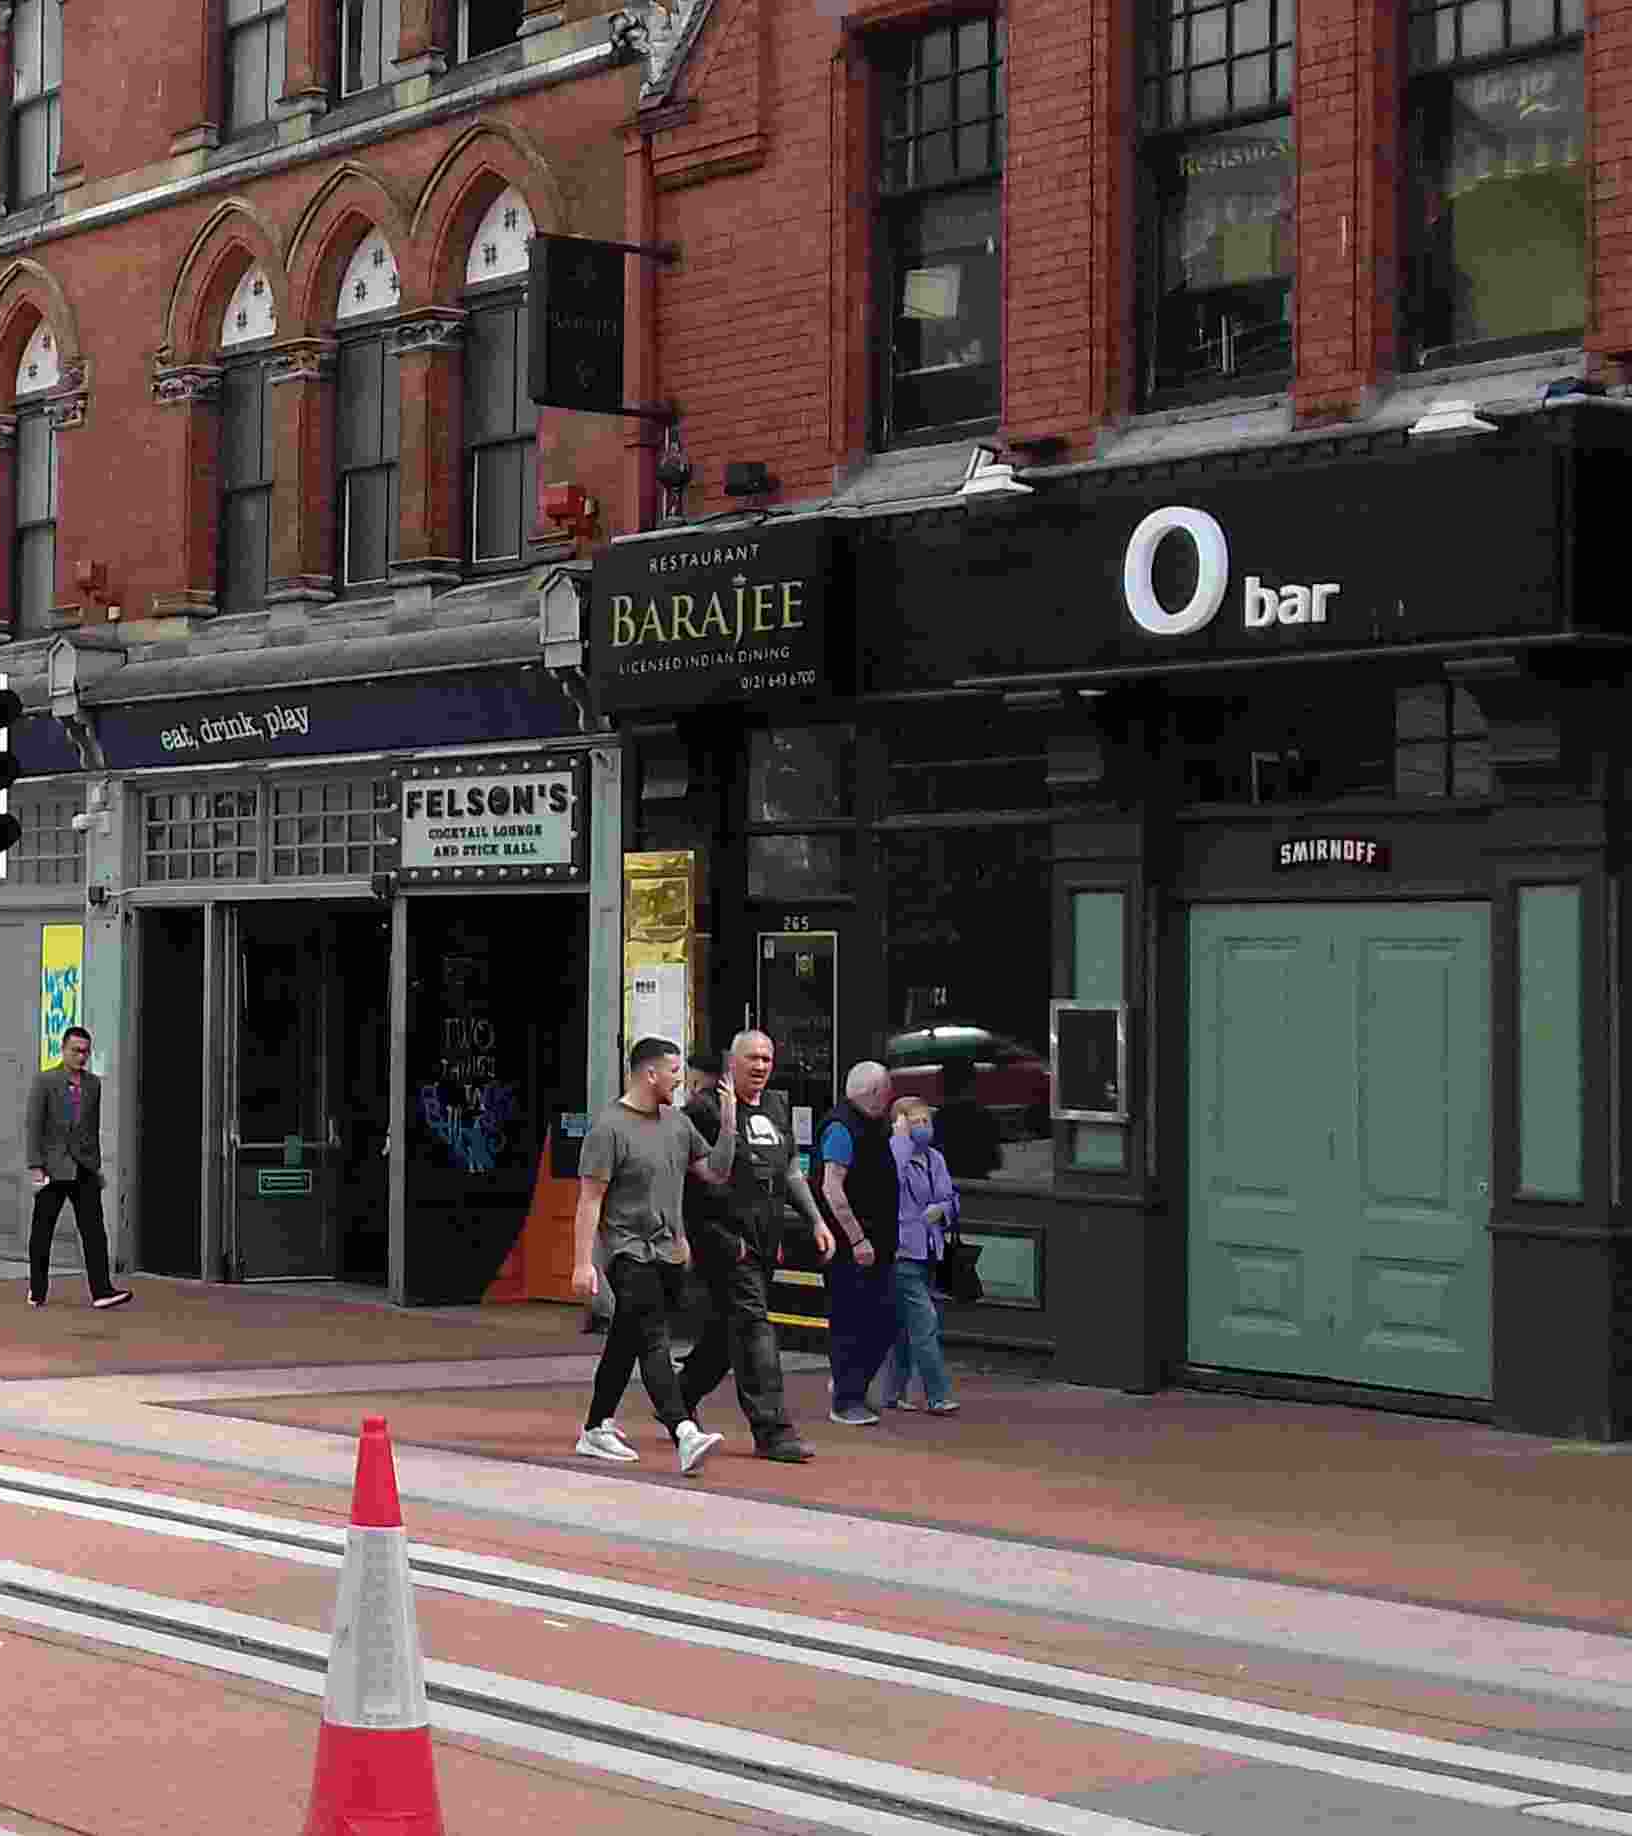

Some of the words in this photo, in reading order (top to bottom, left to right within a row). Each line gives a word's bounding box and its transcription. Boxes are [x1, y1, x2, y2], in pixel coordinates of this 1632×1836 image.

[648, 543, 761, 574] RESTAURANT
[1124, 505, 1230, 636] O
[1244, 575, 1341, 627] bar
[609, 575, 805, 648] BARAJEE
[618, 655, 682, 676] LICENSED
[684, 652, 735, 671] INDIAN
[737, 645, 792, 665] DINING
[740, 673, 766, 690] 0121
[263, 704, 311, 740] play
[405, 782, 569, 820] FELSON'S
[428, 823, 489, 841] COCKTAIL
[432, 843, 460, 857] AND
[1280, 839, 1377, 865] SMIRNOFF
